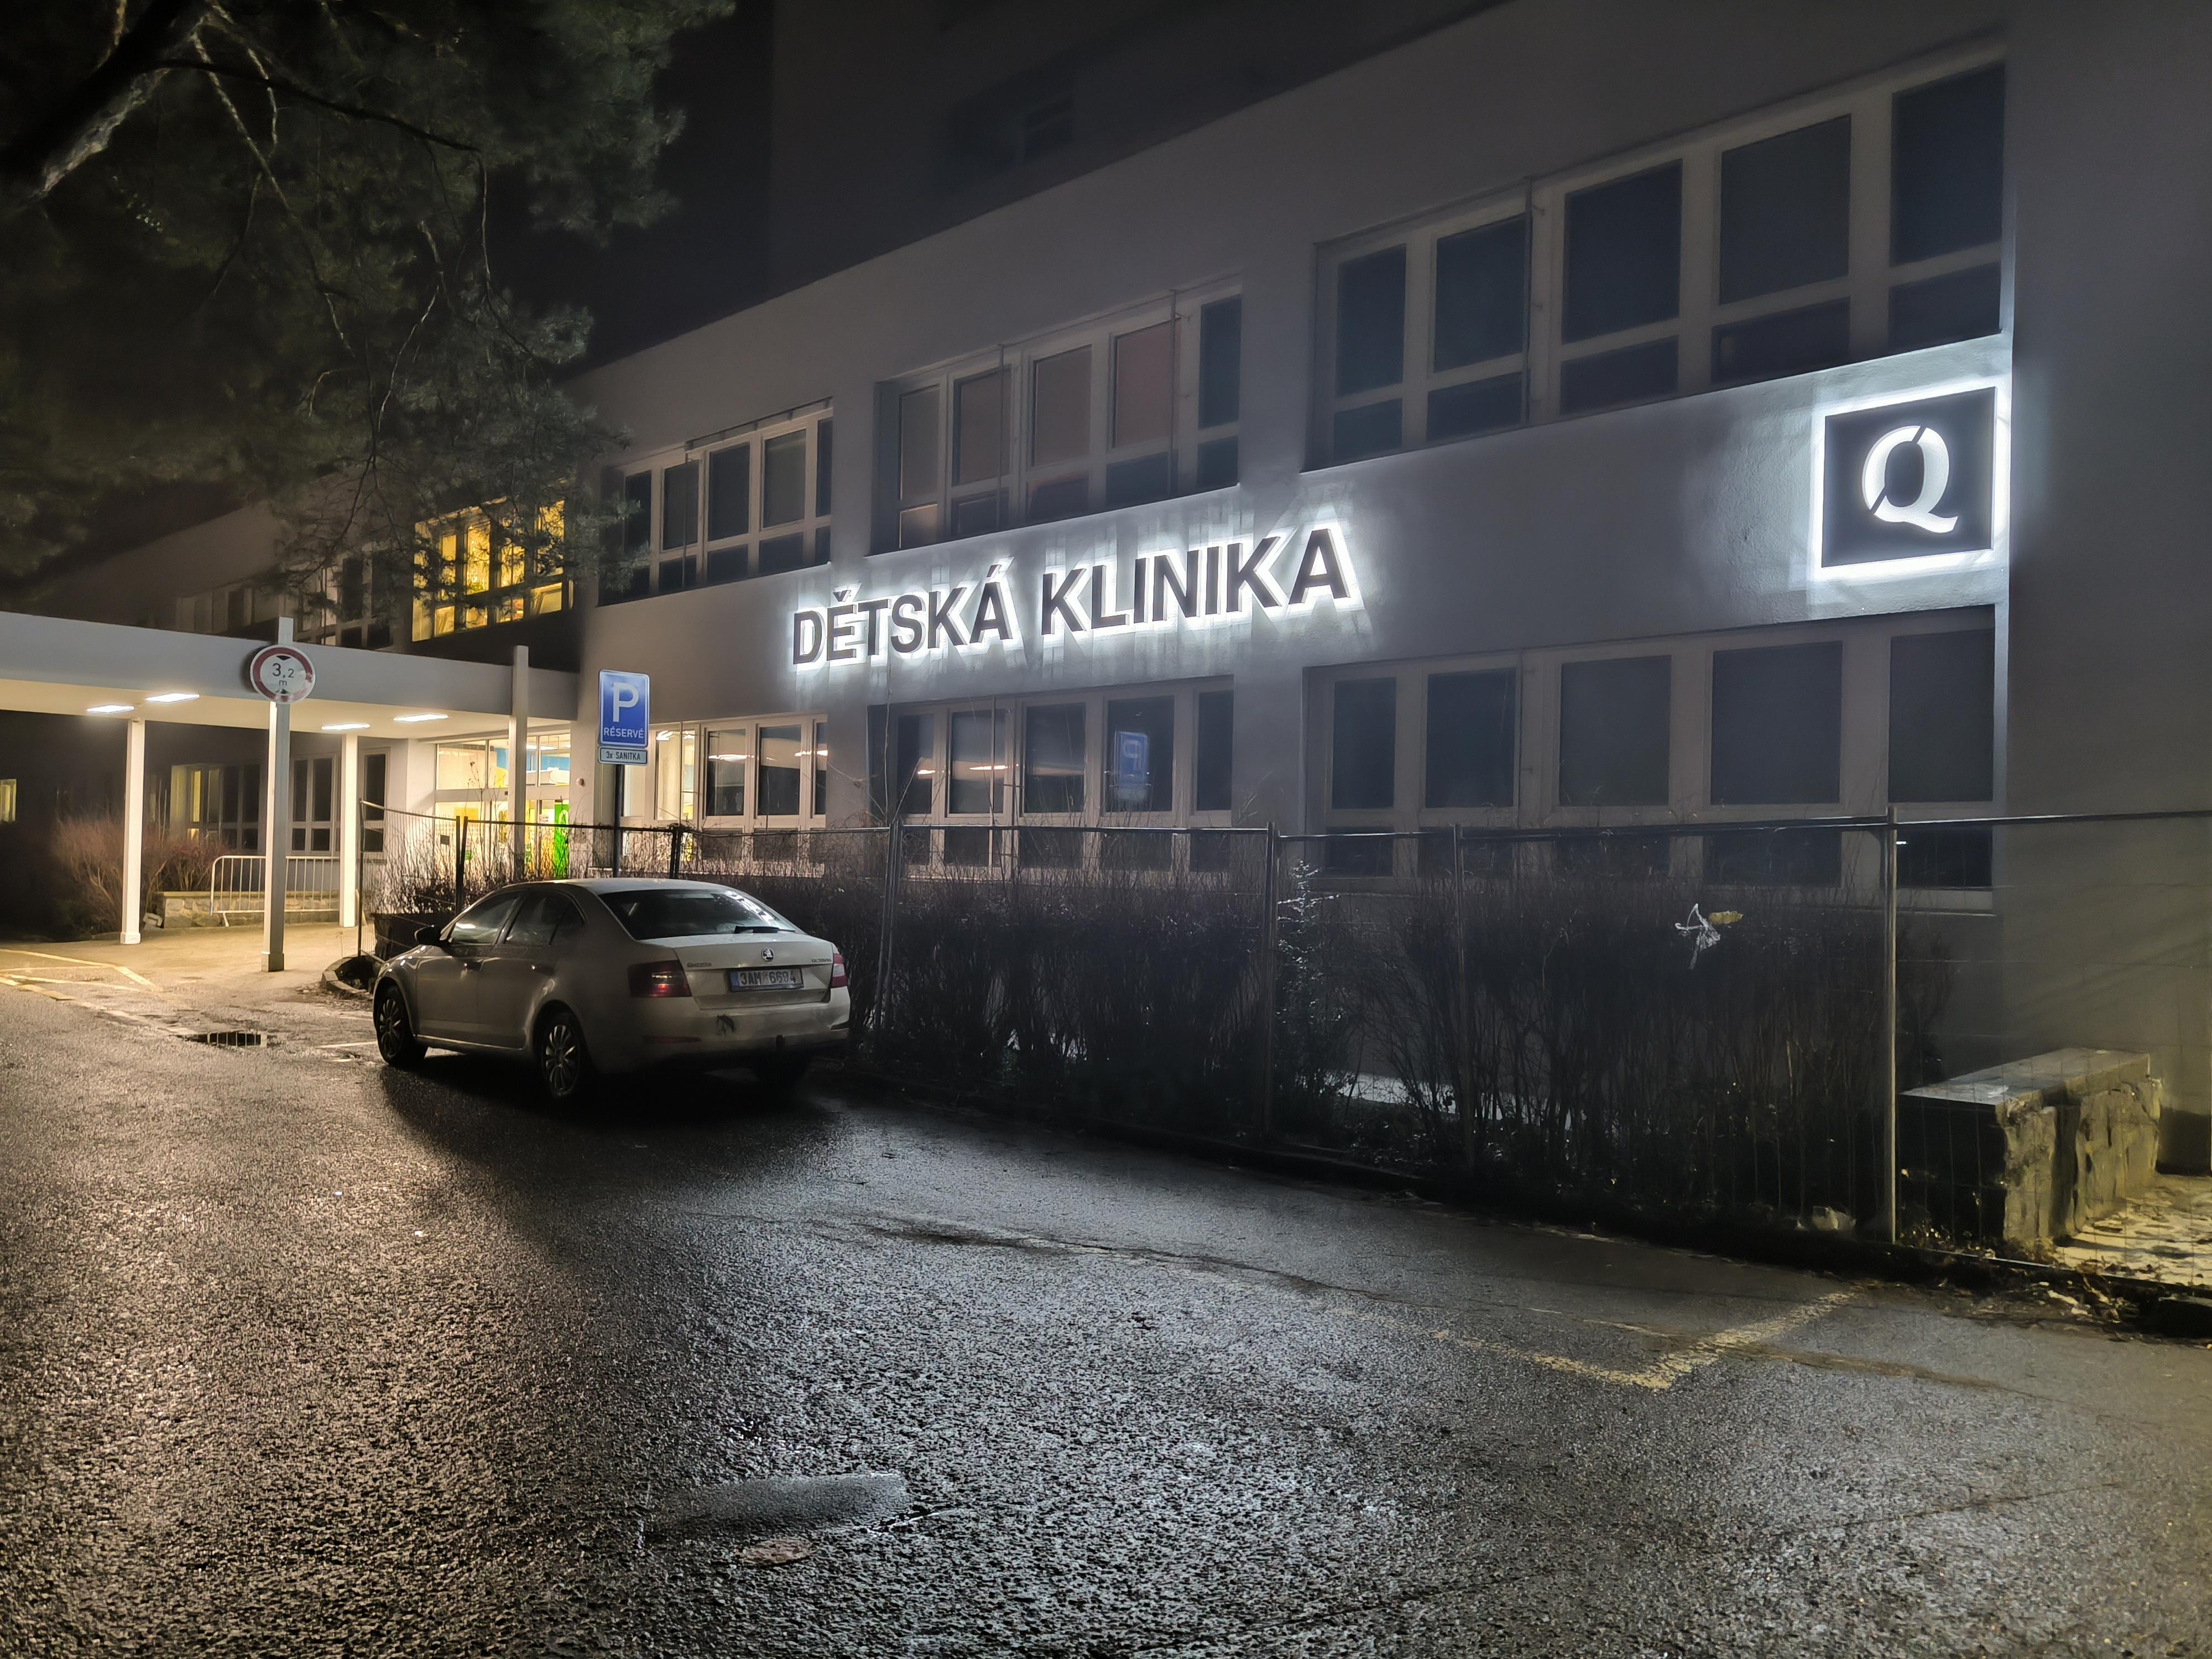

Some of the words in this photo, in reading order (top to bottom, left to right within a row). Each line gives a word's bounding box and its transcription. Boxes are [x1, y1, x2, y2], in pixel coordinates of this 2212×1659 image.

[1861, 425, 1959, 534] Q
[792, 562, 1014, 665] DĚTSKÁ
[1041, 528, 1353, 636] KLINIKA
[272, 662, 295, 679] 3,2
[613, 681, 639, 722] P
[603, 726, 644, 739] RÉSERVÉ
[606, 751, 613, 759] 3x
[615, 751, 641, 761] SANITKA
